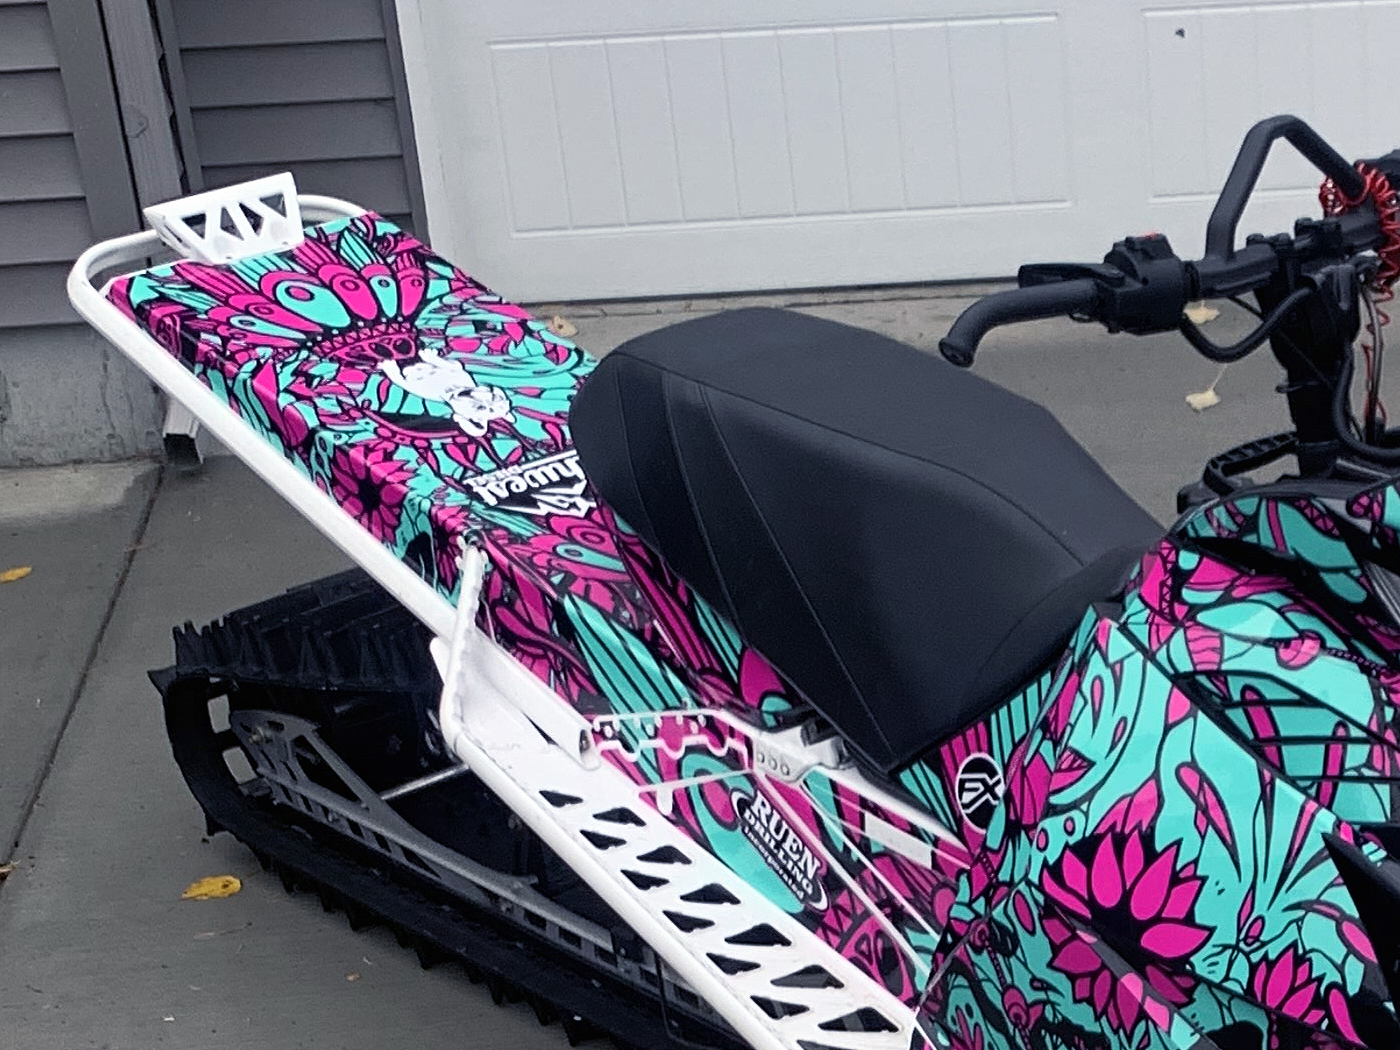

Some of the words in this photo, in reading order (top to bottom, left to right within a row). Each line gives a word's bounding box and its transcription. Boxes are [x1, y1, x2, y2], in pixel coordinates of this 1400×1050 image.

[473, 456, 586, 506] hwest
[745, 809, 813, 895] DRILLING
[751, 790, 820, 880] RUEN
